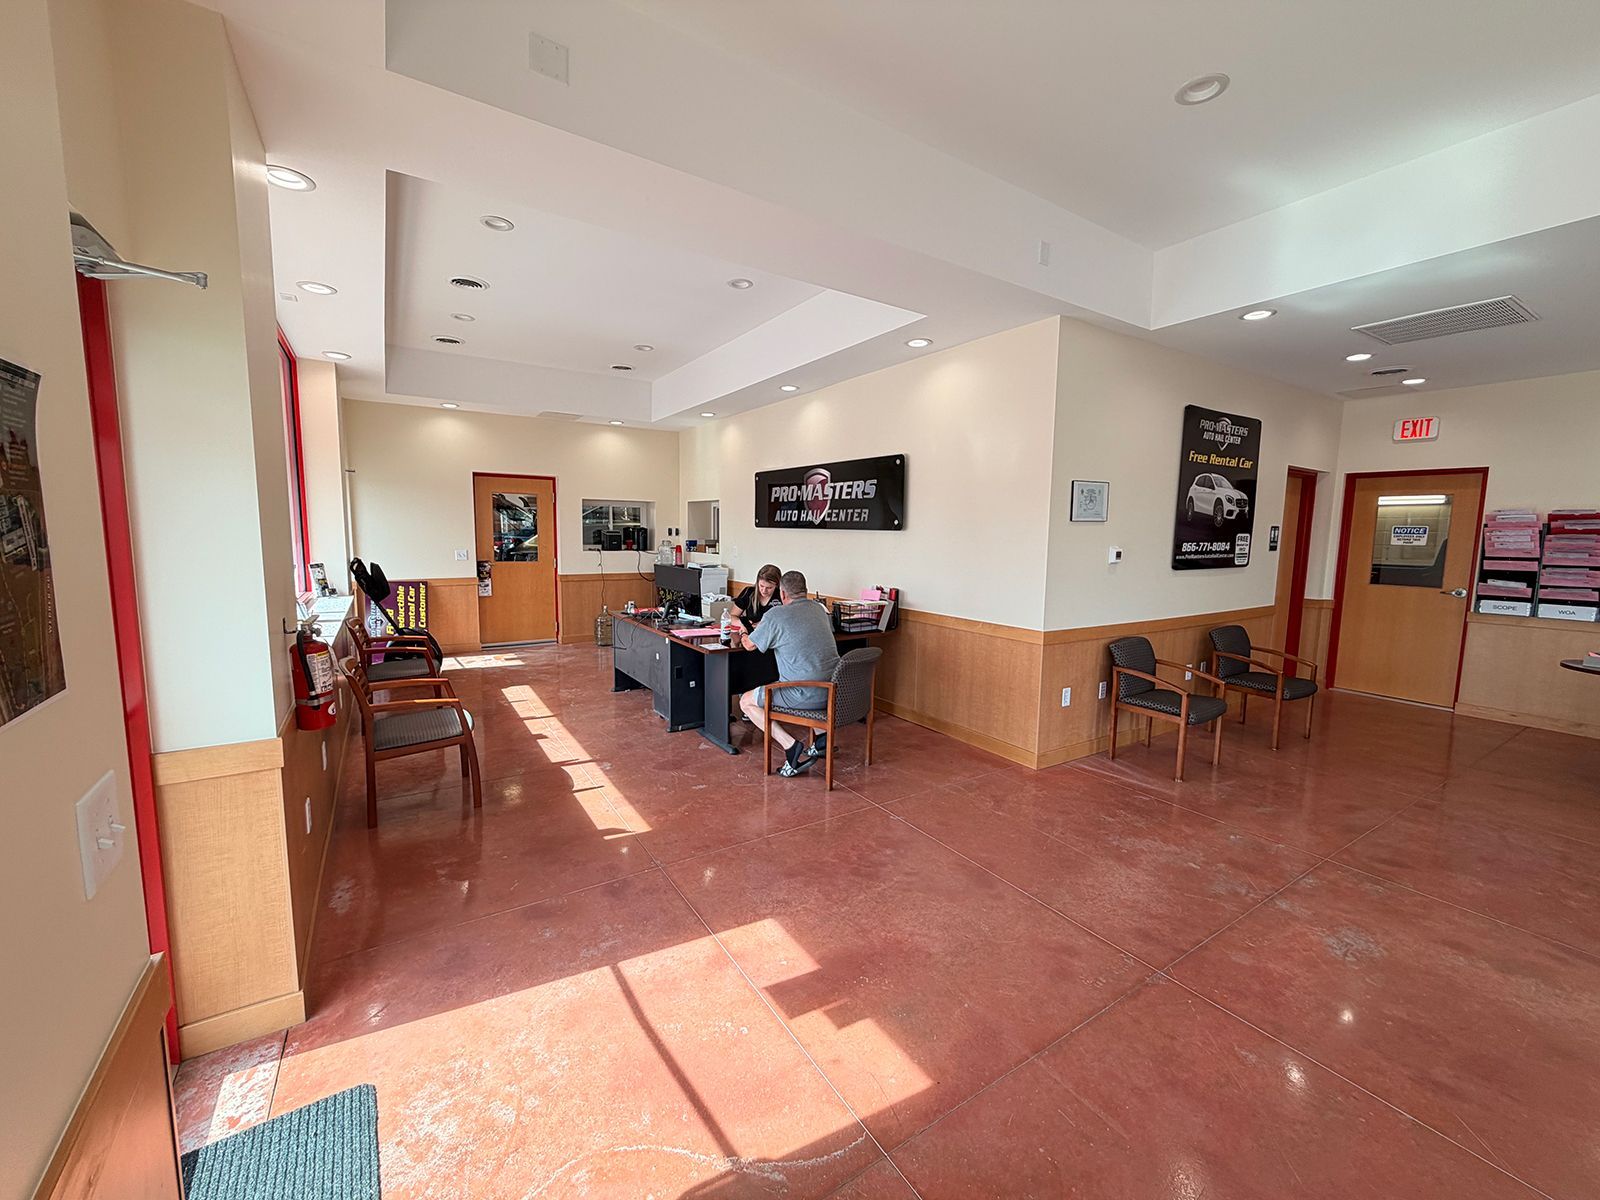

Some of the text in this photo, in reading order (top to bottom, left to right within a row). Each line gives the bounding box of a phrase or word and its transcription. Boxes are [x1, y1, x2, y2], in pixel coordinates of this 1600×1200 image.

[1203, 431, 1214, 441] AUTO
[1225, 435, 1242, 445] CENTER
[1400, 418, 1433, 439] EXIT
[1188, 450, 1254, 469] Free Rental Car
[774, 508, 869, 522] AUTO HAIL CENTER
[396, 585, 405, 629] eductible
[408, 585, 416, 629] ental Car
[418, 582, 426, 628] Customer
